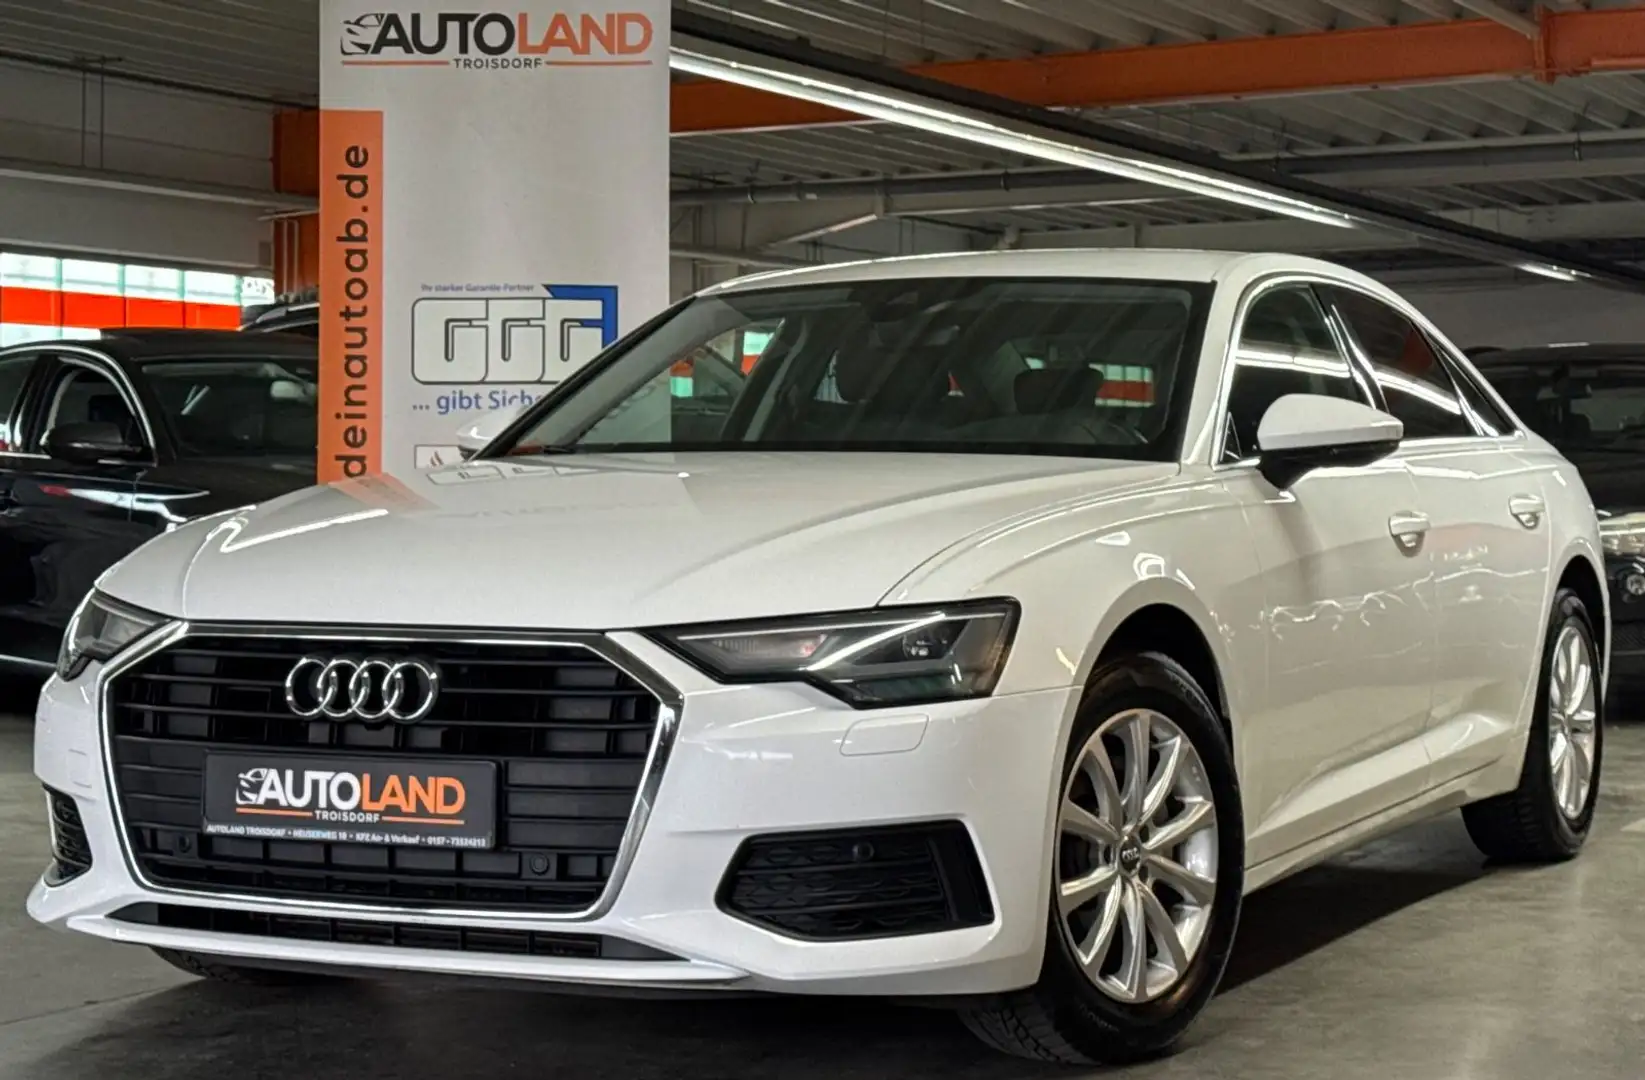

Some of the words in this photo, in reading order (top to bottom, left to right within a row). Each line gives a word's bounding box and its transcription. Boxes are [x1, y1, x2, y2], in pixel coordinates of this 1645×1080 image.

[371, 12, 653, 55] AUTOLAND
[453, 58, 543, 70] TROISDORF
[335, 144, 369, 478] deinautoab.de
[436, 389, 482, 415] gibt
[256, 768, 466, 815] AUTOLAND
[314, 809, 380, 824] TROISDORF
[206, 824, 245, 835] AUTOLAND
[246, 826, 286, 837] TROISDORF
